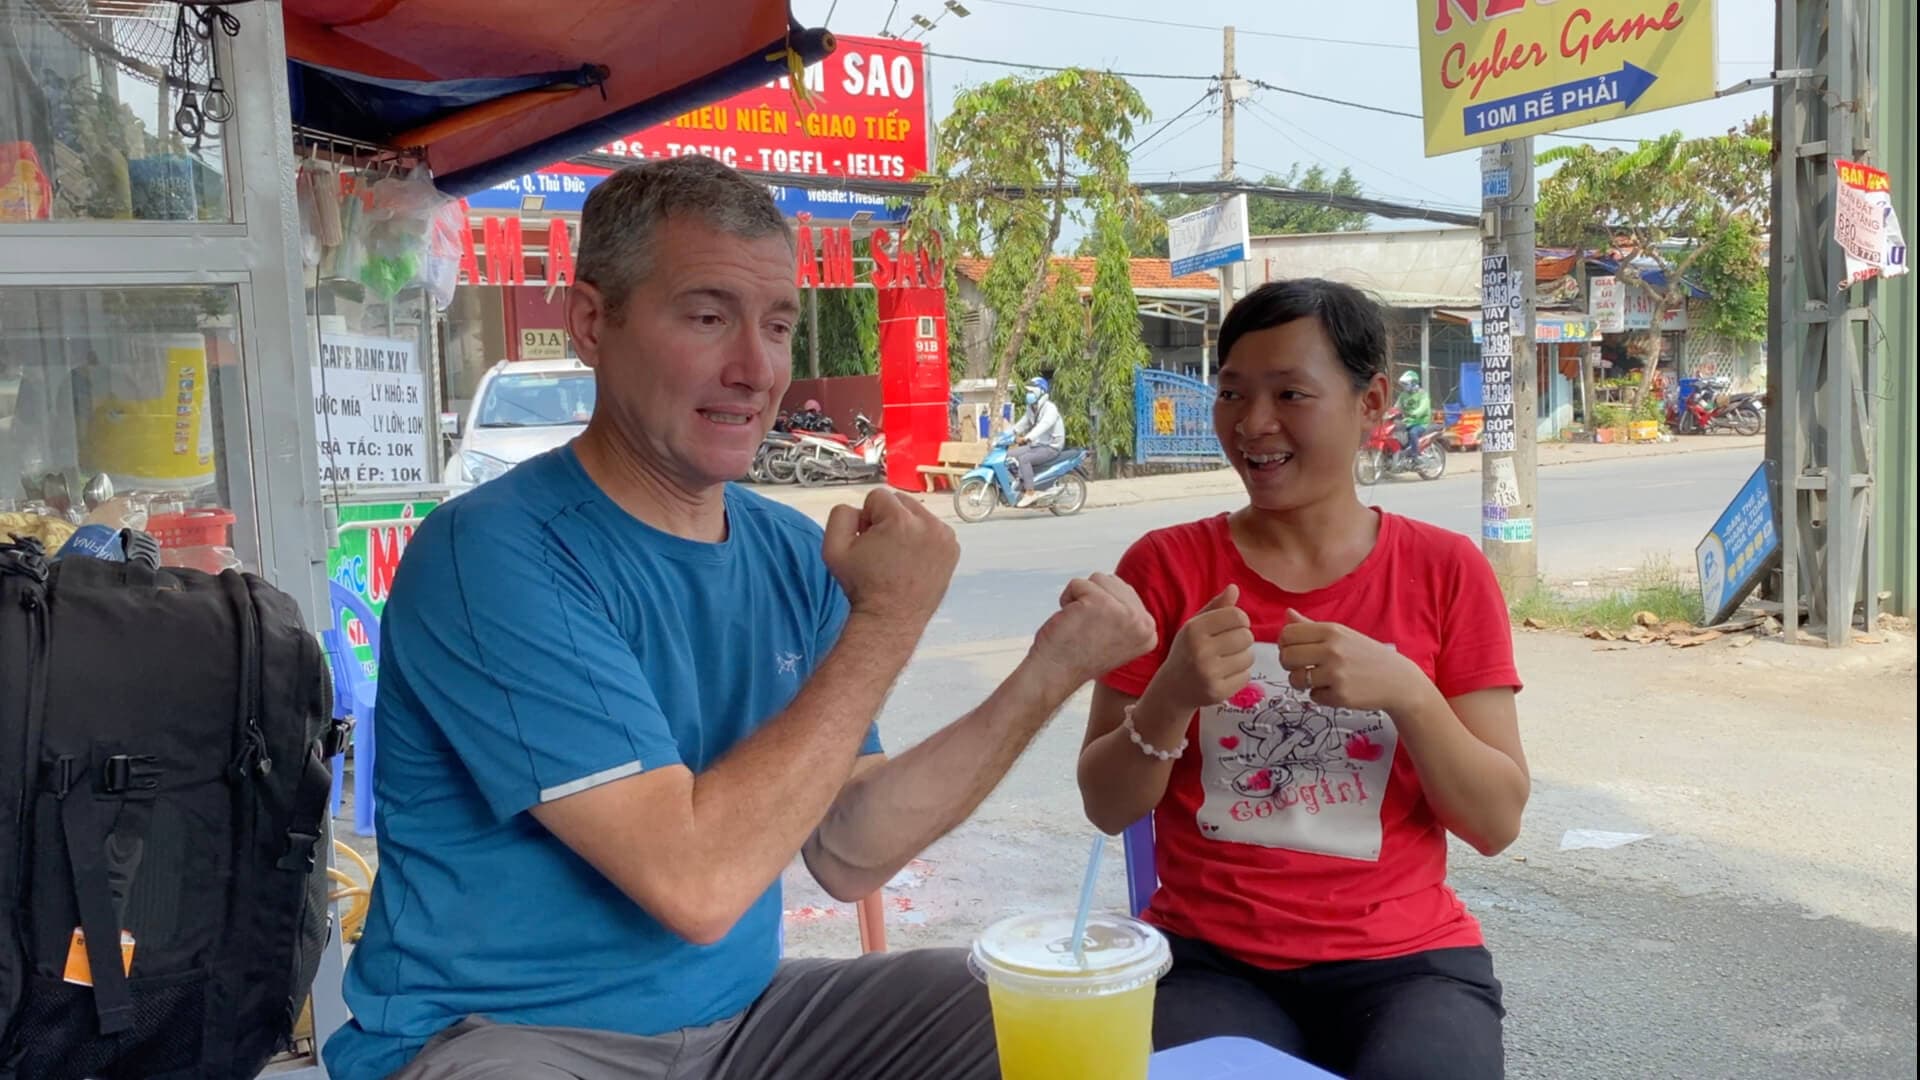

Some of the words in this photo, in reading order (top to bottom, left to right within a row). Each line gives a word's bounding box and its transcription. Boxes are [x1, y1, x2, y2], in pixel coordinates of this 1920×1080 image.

[1440, 28, 1547, 100] Cyber
[1560, 1, 1685, 65] Game
[842, 52, 915, 99] SAO
[1475, 105, 1517, 129] 10M
[1524, 92, 1554, 119] RẼ
[1562, 76, 1619, 111] PHẢI
[736, 103, 788, 135] NIÊN
[806, 112, 857, 139] GIAO
[863, 108, 912, 141] TIẾP
[758, 147, 828, 174] TOEFL
[847, 153, 905, 176] IELTS
[537, 174, 560, 192] Thủ
[563, 175, 586, 192] Đức
[1483, 257, 1504, 270] VAY
[1484, 307, 1506, 319] VAY
[524, 332, 561, 346] 91A
[915, 341, 938, 353] 91B
[322, 343, 352, 370] CAFE
[355, 347, 385, 372] RANG
[387, 349, 408, 374] XAY
[1485, 356, 1509, 368] VAY
[371, 383, 382, 402] LY
[407, 385, 418, 404] 5K
[341, 395, 362, 417] MÍA
[1486, 404, 1511, 416] VAY
[373, 414, 385, 433] LY
[408, 416, 424, 435] 10K
[387, 443, 413, 457] 10K
[357, 463, 384, 482] ÉP:
[391, 467, 422, 482] 10K
